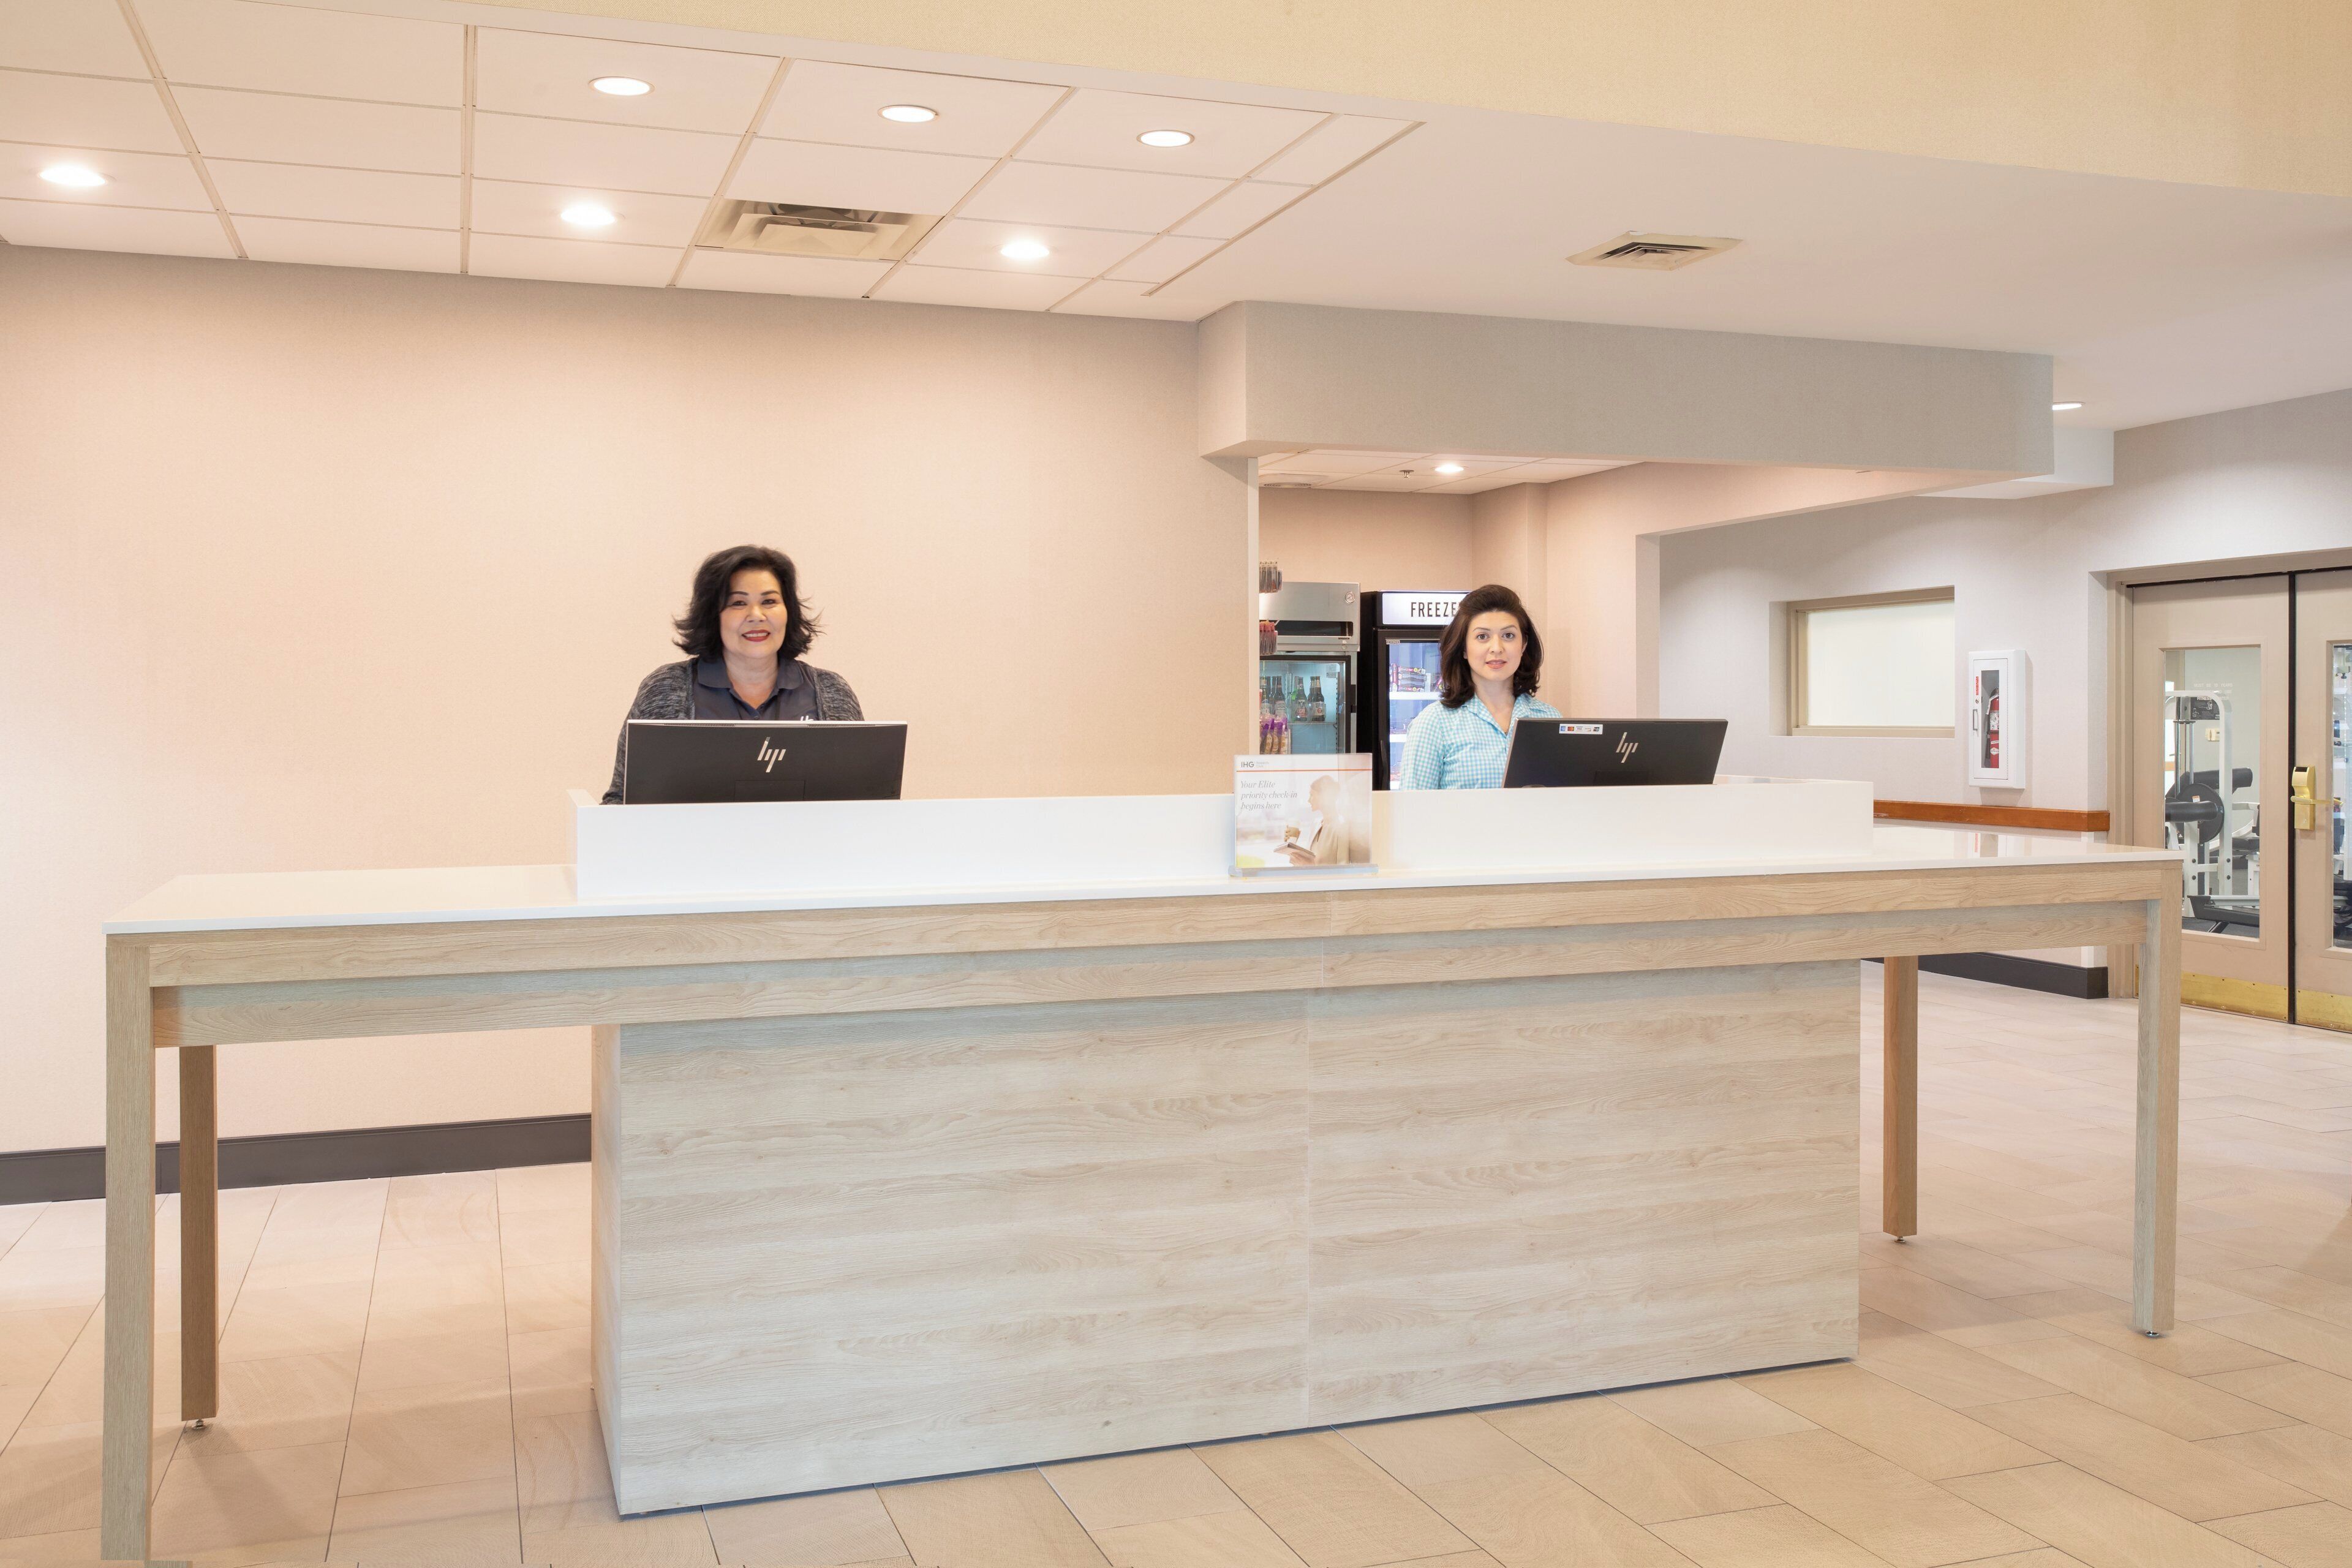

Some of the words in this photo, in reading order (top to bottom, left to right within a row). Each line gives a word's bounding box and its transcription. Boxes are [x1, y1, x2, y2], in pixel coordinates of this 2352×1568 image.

[1411, 601, 1460, 617] FREEZE
[757, 737, 786, 773] hp
[1616, 732, 1638, 763] hp
[1240, 791, 1267, 801] priority
[1268, 790, 1297, 799] check-in
[1240, 802, 1265, 811] begins
